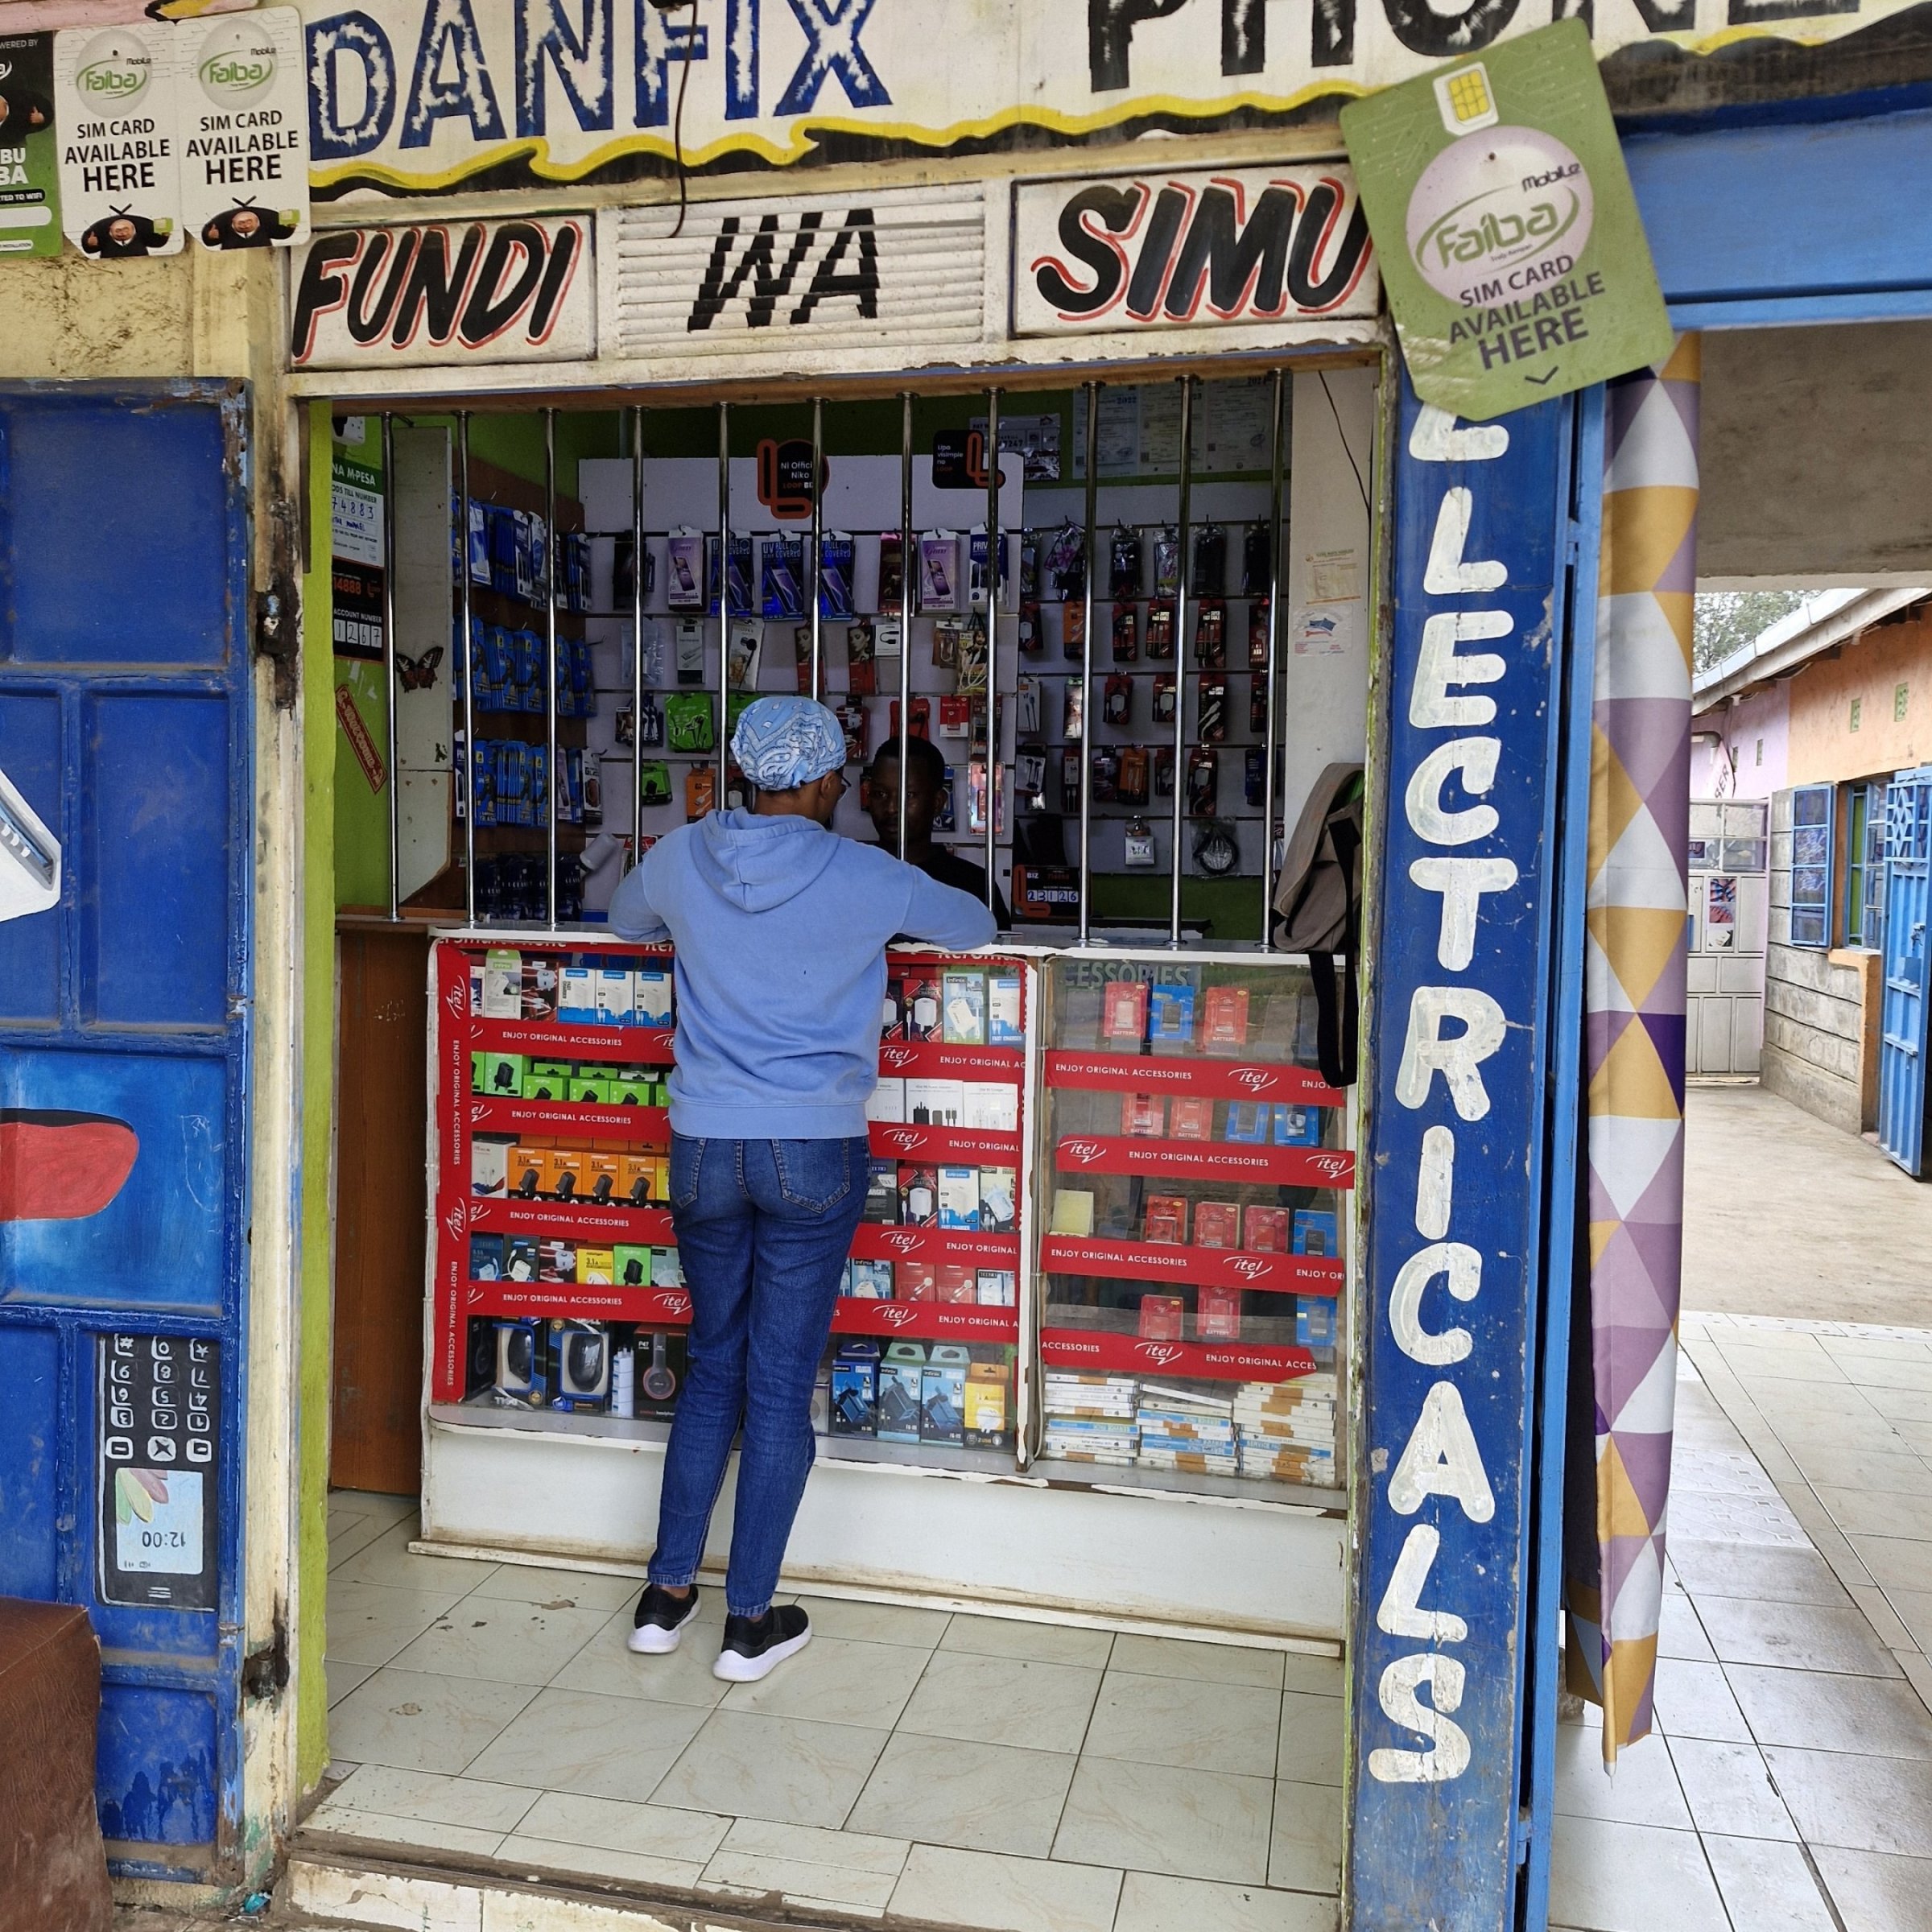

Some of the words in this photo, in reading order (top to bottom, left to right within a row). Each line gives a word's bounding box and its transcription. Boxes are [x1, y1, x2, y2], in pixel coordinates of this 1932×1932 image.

[28, 39, 39, 47] BY
[306, 0, 892, 160] DANFIX
[77, 122, 105, 139] SIM
[110, 119, 155, 135] CARD
[200, 115, 230, 131] SIM
[236, 110, 282, 128] CARD
[64, 138, 170, 164] AVAILABLE
[186, 130, 299, 158] AVAILABLE
[83, 162, 155, 192] HERE
[206, 155, 282, 184] HERE
[1521, 163, 1580, 192] Mobile
[292, 220, 583, 363] FUNDI
[687, 208, 878, 332] WA
[1032, 177, 1375, 320] SIMU
[1459, 282, 1504, 309] SIM
[1509, 254, 1574, 291] CARD
[1450, 271, 1605, 344] AVAILABLE
[1478, 307, 1589, 370] HERE
[791, 461, 813, 469] Offici
[791, 471, 810, 479] Niko
[502, 1031, 527, 1040] ENJOY
[530, 1033, 567, 1042] ORIGINAL
[570, 1035, 622, 1046] ACCESSORIES
[940, 1056, 966, 1065] ENJOY
[970, 1057, 1011, 1067] ORIGINAL
[1055, 1063, 1084, 1072] ENJOY
[1086, 1065, 1129, 1075] ORIGINAL
[1132, 1069, 1192, 1080] ACCESSORIES
[512, 1110, 537, 1119] ENJOY
[539, 1112, 576, 1121] ORIGINAL
[579, 1114, 632, 1125] ACCESSORIES
[949, 1140, 976, 1149] ENJOY
[979, 1141, 1019, 1152] ORIGINAL
[1129, 1151, 1158, 1160] ENJOY
[1160, 1153, 1204, 1163] ORIGINAL
[1208, 1156, 1269, 1166] ACCESSORIES
[510, 1212, 535, 1220] ENJOY
[537, 1213, 574, 1223] ORIGINAL
[577, 1216, 630, 1228] ACCESSORIES
[947, 1242, 973, 1251] ENJOY
[976, 1244, 1018, 1254] ORIGINAL
[1051, 1249, 1080, 1258] ENJOY
[1081, 1251, 1125, 1261] ORIGINAL
[1127, 1255, 1187, 1266] ACCESSORIES
[1296, 1269, 1326, 1278] ENJOY
[449, 1289, 457, 1329] ORIGINAL
[503, 1294, 528, 1302] ENJOY
[530, 1294, 568, 1304] ORIGINAL
[570, 1296, 622, 1306] ACCESSORIES
[939, 1315, 965, 1324] ENJOY
[968, 1317, 1009, 1327] ORIGINAL
[447, 1331, 456, 1386] ACCESSORIES
[1042, 1341, 1100, 1352] ACCESSORIES
[1206, 1354, 1235, 1363] ENJOY
[1237, 1356, 1282, 1367] ORIGINAL
[142, 1530, 187, 1548] 12:00
